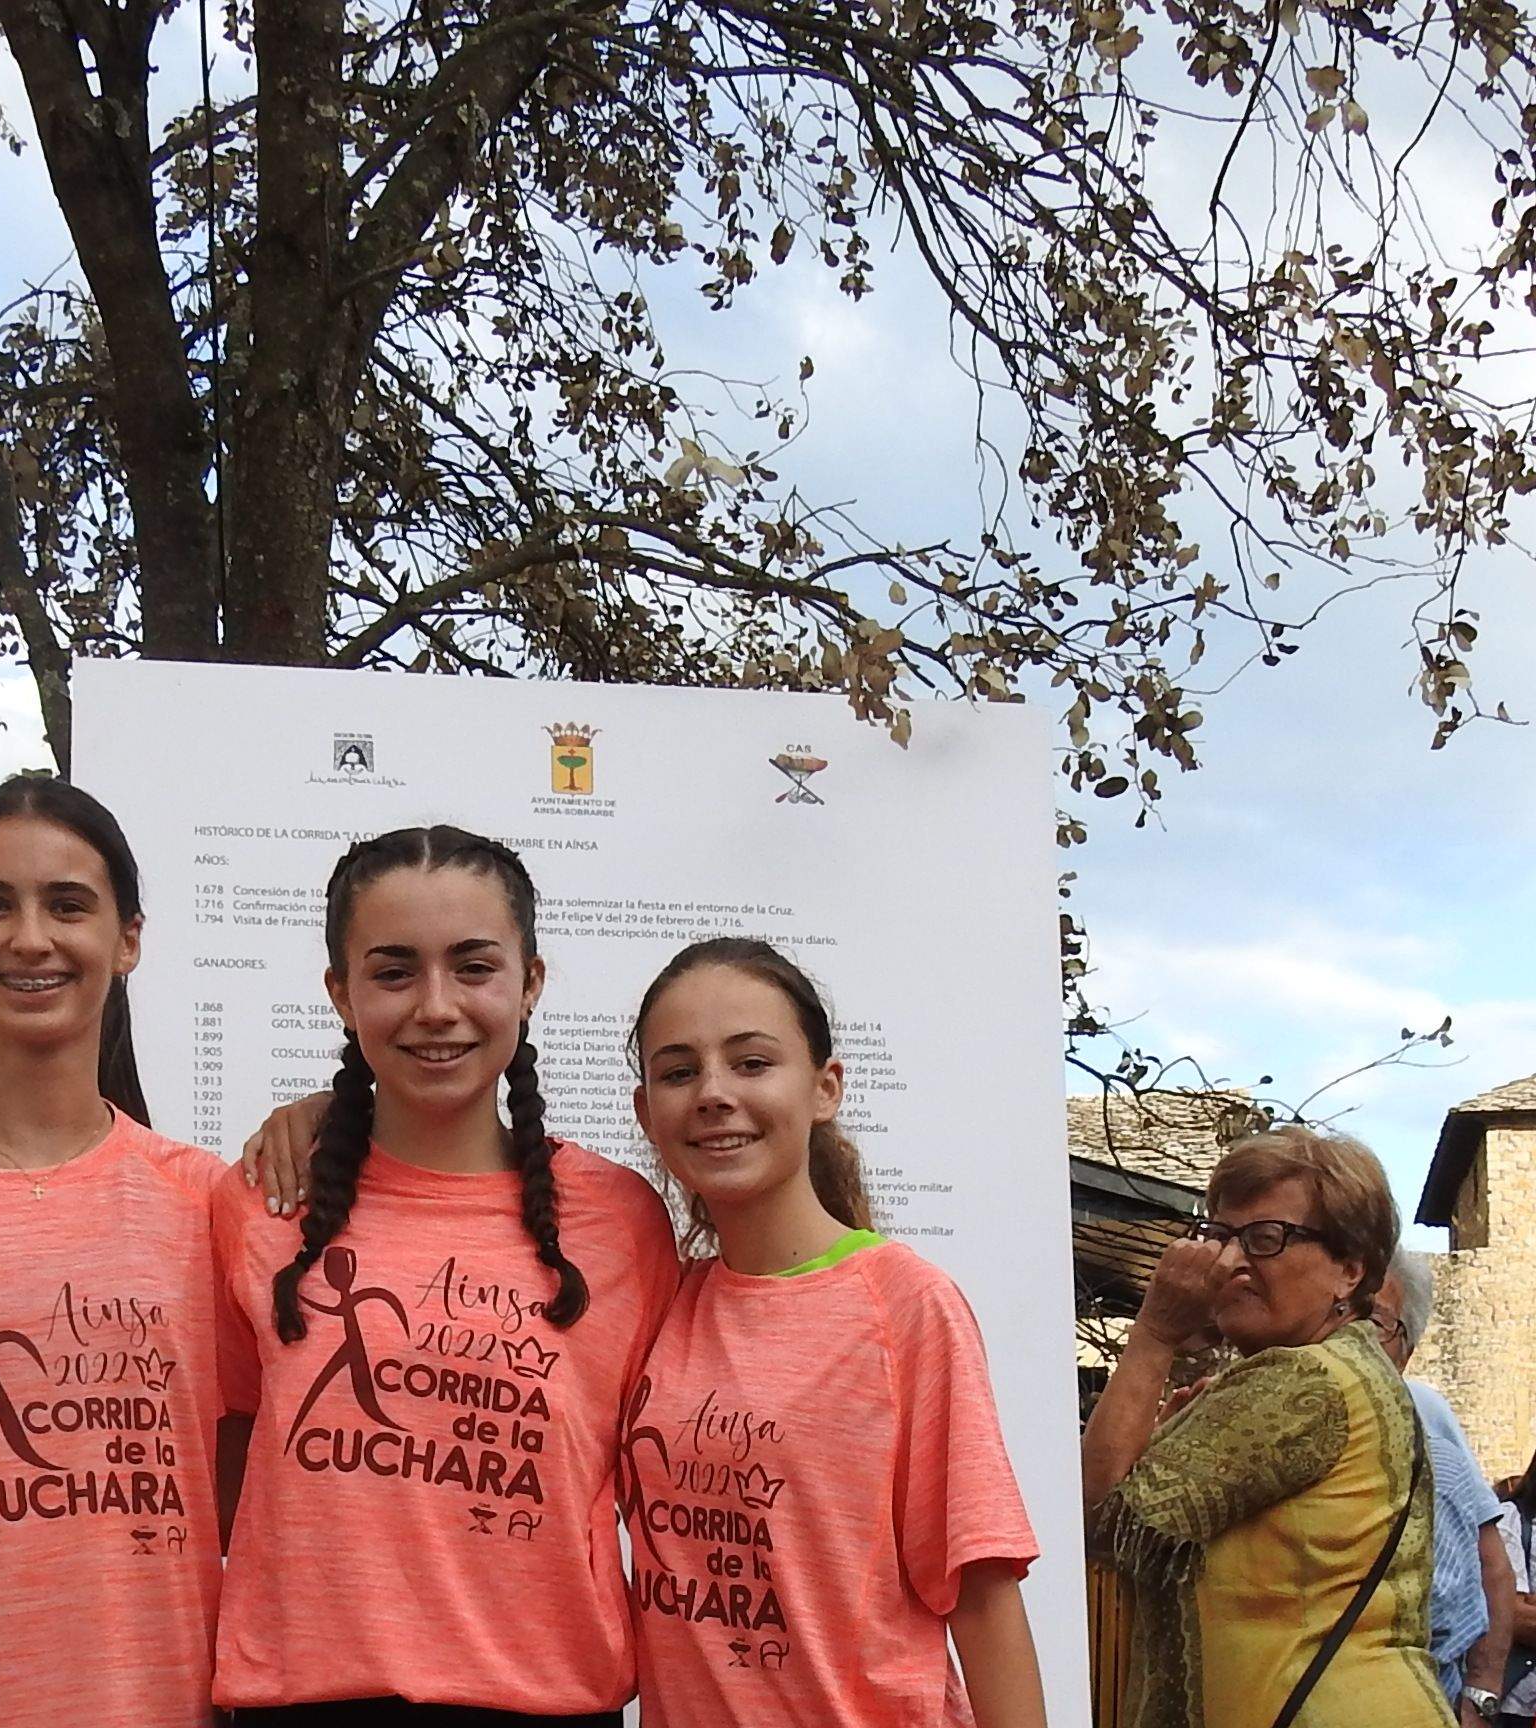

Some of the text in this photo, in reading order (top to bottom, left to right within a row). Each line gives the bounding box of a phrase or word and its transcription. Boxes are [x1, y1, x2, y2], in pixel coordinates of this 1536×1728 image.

[530, 797, 616, 807] AYUNTAMIENTO DE
[194, 825, 598, 850] HISTÓRICO DE LA CORRIDA EN AÍNSA
[194, 854, 229, 865] AÑOS:
[195, 884, 224, 894] 1.678
[233, 885, 290, 897] Concesión
[292, 887, 307, 897] de
[566, 898, 622, 909] solemnizar
[625, 899, 634, 909] la
[637, 900, 665, 910] fiesta
[668, 903, 681, 911] en
[684, 902, 693, 912] el
[696, 904, 737, 914] entorno
[740, 904, 754, 914] de
[757, 905, 765, 914] la
[768, 906, 794, 916] Cruz.
[195, 899, 224, 909] 1.716
[233, 900, 306, 912] Confirmación
[545, 912, 558, 921] de
[562, 912, 592, 923] Felipe
[595, 913, 603, 922] V
[605, 912, 621, 923] del
[625, 914, 637, 923] 29
[640, 915, 653, 924] de
[656, 915, 694, 926] febrero
[697, 916, 711, 926] de
[195, 914, 224, 924] 1.794
[233, 915, 262, 925] Visita
[265, 916, 279, 926] de
[282, 916, 325, 927] Francisc
[575, 928, 590, 937] con
[593, 928, 658, 940] descripción
[661, 929, 674, 940] de
[677, 930, 685, 940] la
[776, 934, 789, 943] en
[791, 935, 803, 944] su
[805, 935, 838, 946] diario.
[193, 957, 267, 969] GANADORES:
[194, 1017, 222, 1027] 1.881
[271, 1018, 304, 1030] GOTA,
[543, 1026, 557, 1036] de
[559, 1027, 620, 1039] septiembre
[195, 1003, 882, 1032] 1.868 GOTA, Entre los años del 14
[194, 1032, 222, 1042] 1.899
[543, 1041, 580, 1051] Noticia
[583, 1042, 615, 1052] Diario
[194, 1046, 896, 1078] 1.905 de casa Morillo de paso
[194, 1061, 907, 1091] 1.909 Noticia Diario de del Zapato
[194, 1076, 222, 1086] 1.913
[271, 1077, 318, 1089] CAVERO,
[580, 1085, 616, 1095] noticia
[194, 1091, 871, 1118] 1.920 nieto José años
[194, 1106, 632, 1126] 1.921 Noticia Diario de
[194, 1120, 222, 1131] 1.922
[194, 1131, 600, 1146] 1.926 nos
[876, 1167, 903, 1177] tarde
[877, 1182, 952, 1193] servicio militar
[921, 1227, 954, 1236] militar
[415, 1322, 497, 1362] 2022
[54, 1352, 128, 1386] 2022
[374, 1358, 551, 1422] CORRIDA
[22, 1397, 172, 1434] CORRIDA
[452, 1412, 544, 1453] de la
[106, 1435, 175, 1466] de la
[296, 1427, 544, 1505] CUCHARA
[675, 1460, 730, 1497] 2022
[647, 1499, 774, 1552] CORRIDA
[707, 1547, 772, 1582] de la
[636, 1568, 787, 1633] UCHARA
